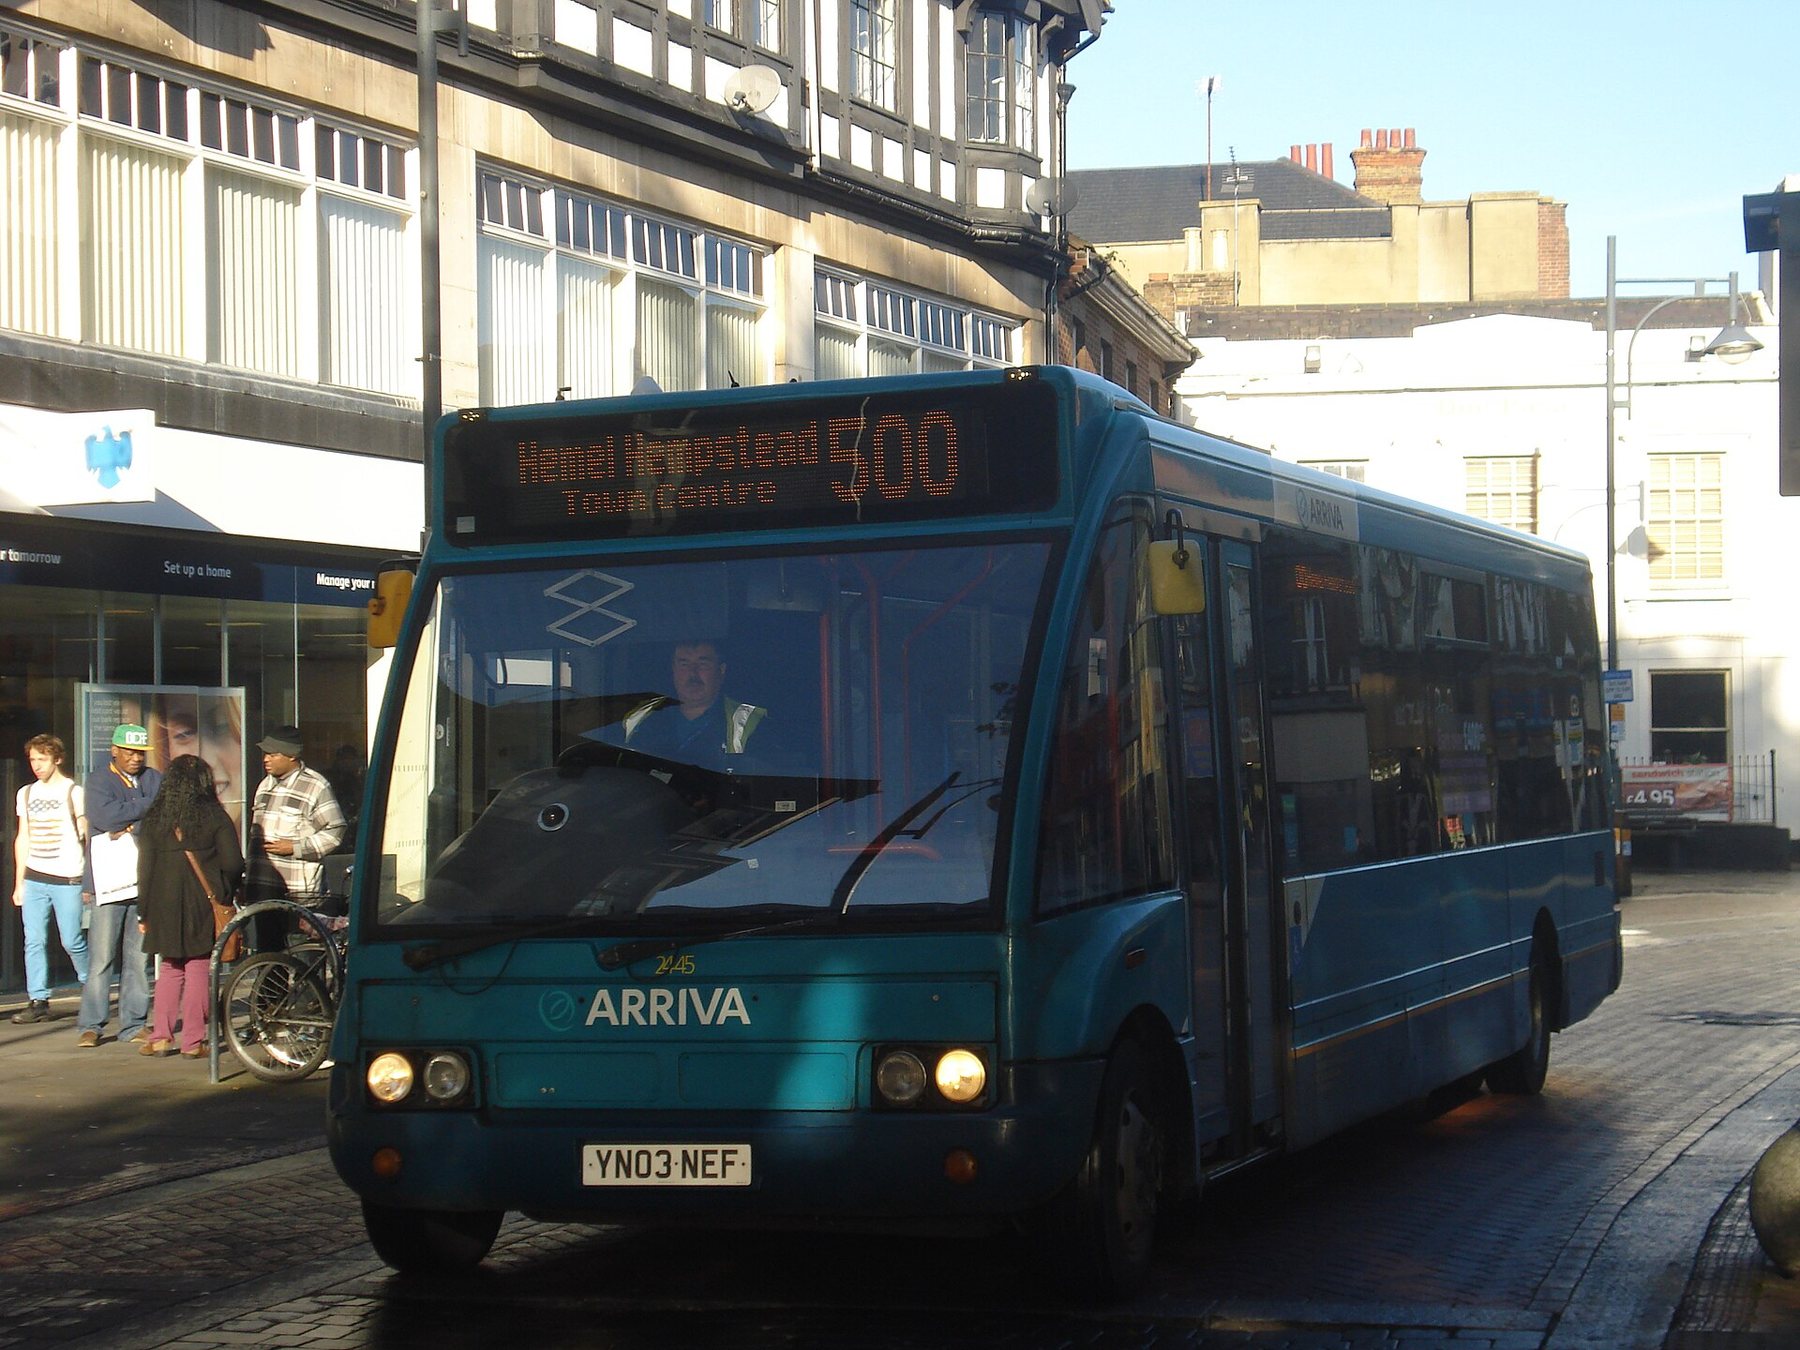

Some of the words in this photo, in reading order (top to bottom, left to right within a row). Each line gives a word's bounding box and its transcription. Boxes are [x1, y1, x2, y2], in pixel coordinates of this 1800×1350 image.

[518, 434, 615, 484] Hemel
[623, 418, 819, 477] Hempstead
[828, 410, 960, 502] 500
[561, 488, 647, 516] Town
[656, 479, 777, 509] Centre
[1310, 498, 1344, 531] ARRIVA
[8, 548, 62, 564] tomorrow
[164, 560, 181, 575] Set
[182, 564, 195, 579] up
[197, 566, 204, 577] a
[206, 564, 232, 579] home
[316, 572, 351, 590] Manage
[350, 577, 371, 591] your
[655, 954, 696, 975] 2445
[584, 987, 752, 1027] ARRIVA
[595, 1149, 672, 1180] YN03
[681, 1149, 739, 1180] NEF
